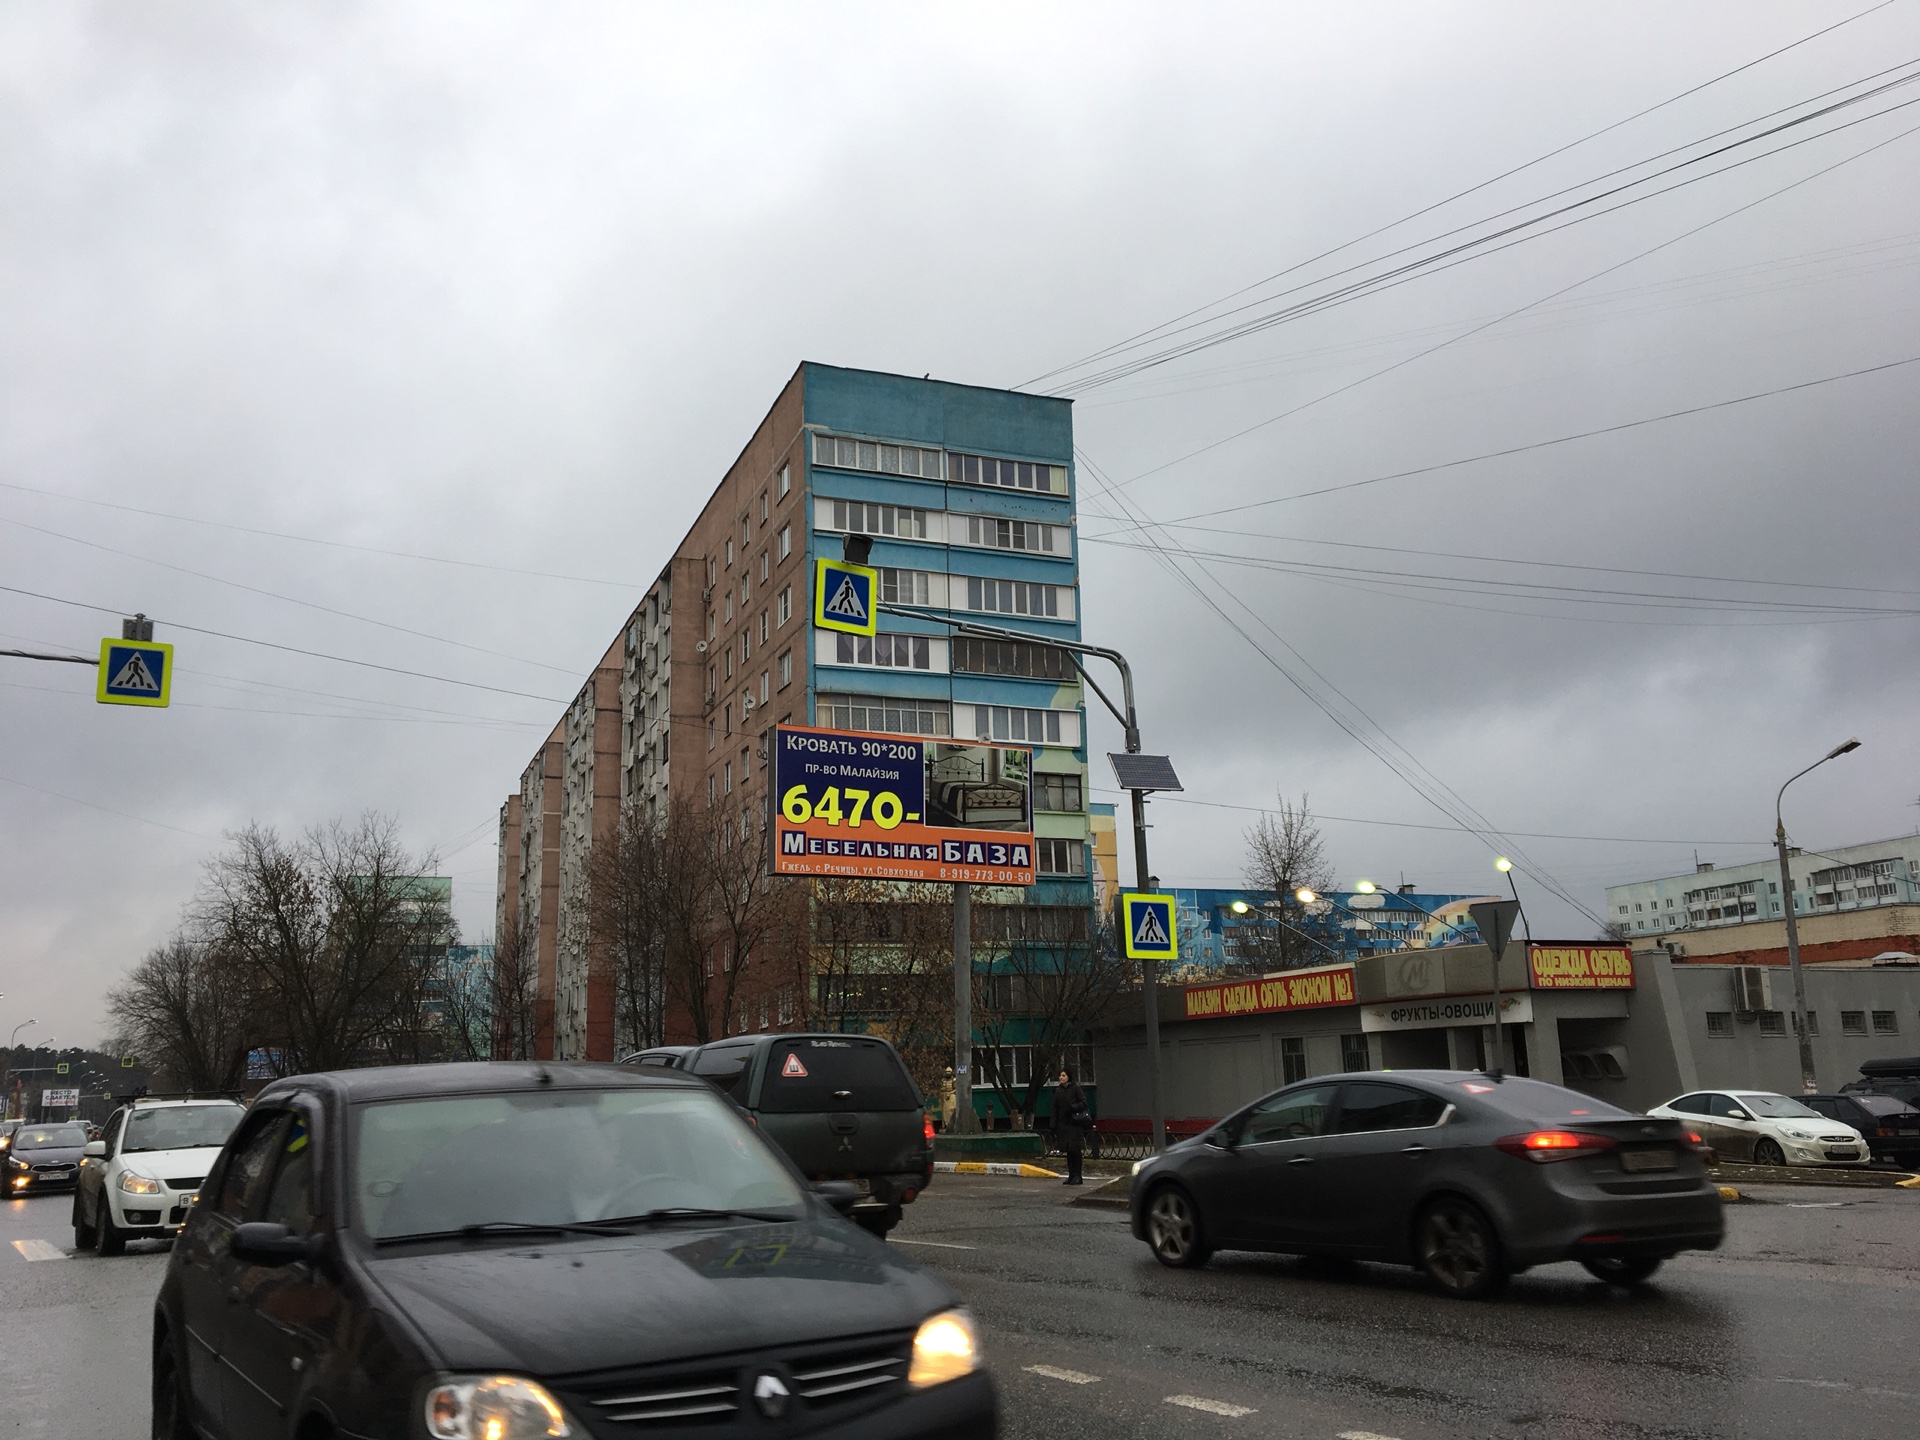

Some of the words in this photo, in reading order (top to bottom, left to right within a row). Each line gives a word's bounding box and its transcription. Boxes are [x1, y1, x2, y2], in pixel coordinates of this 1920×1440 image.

[782, 784, 920, 829] 6470-
[940, 867, 1031, 883] 8-919-773-00-50
[1532, 949, 1590, 977] ОДЕЖДА
[1590, 949, 1632, 975] ОБУВЬ
[1538, 977, 1553, 986] ПО
[1554, 977, 1596, 986] НИЗКИМ
[1596, 978, 1631, 987] ЦЕНАМ
[1186, 989, 1221, 1016] МАГАЗИН
[1223, 985, 1259, 1014] ОДЕЖДА
[1260, 981, 1288, 1009] ОБУВЬ
[1289, 975, 1332, 1006] ЭКОНОМ
[1333, 973, 1353, 1002] №1
[1390, 1002, 1494, 1023] ФРУКТЫ-ОВОЩИ
